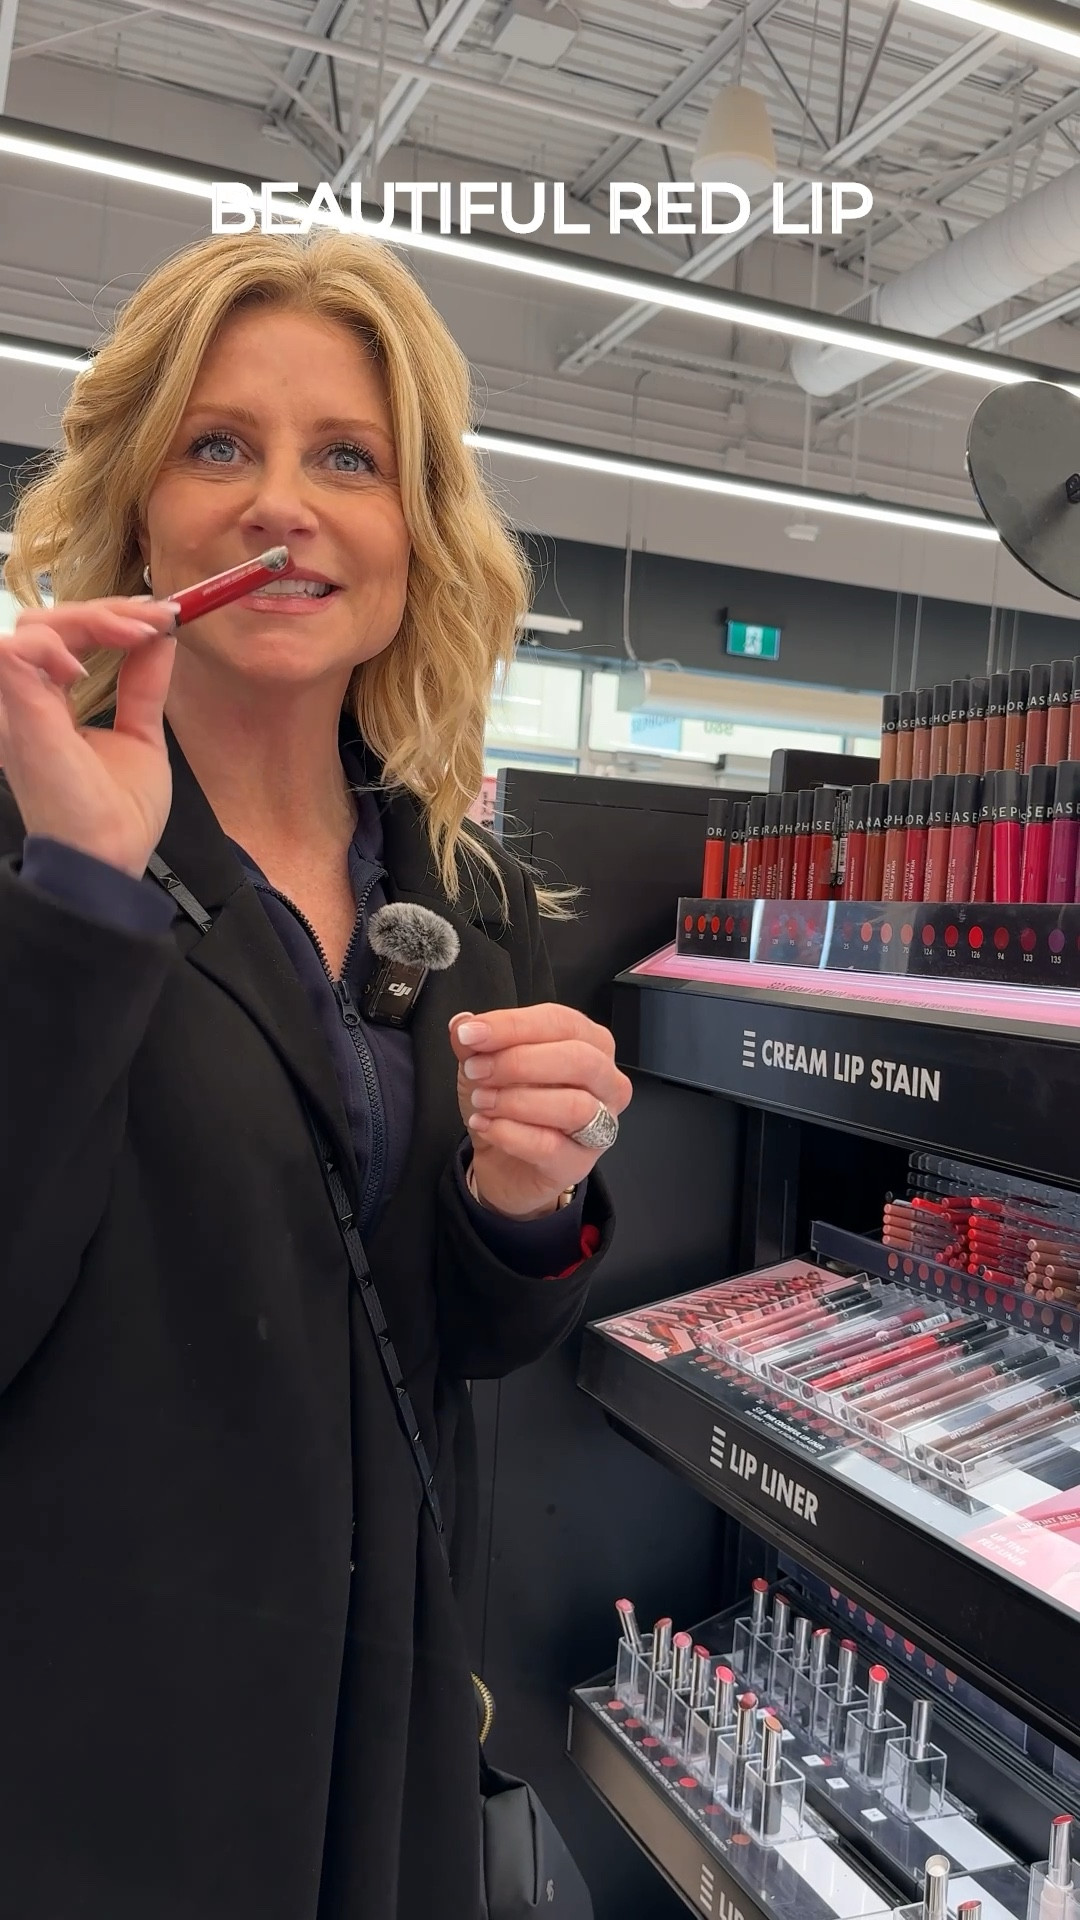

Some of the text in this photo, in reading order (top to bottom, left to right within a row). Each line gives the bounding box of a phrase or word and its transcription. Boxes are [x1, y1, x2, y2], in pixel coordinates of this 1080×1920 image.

[923, 948, 933, 956] 124
[947, 949, 956, 957] 125
[971, 951, 981, 959] 126
[997, 952, 1005, 960] 94
[1023, 953, 1033, 962] 133
[1050, 955, 1062, 964] 135
[761, 1039, 941, 1102] CREAM LIP STAIN
[729, 1443, 819, 1527] LIP LINER
[1034, 1515, 1057, 1526] TINT
[1057, 1511, 1079, 1522] FELT
